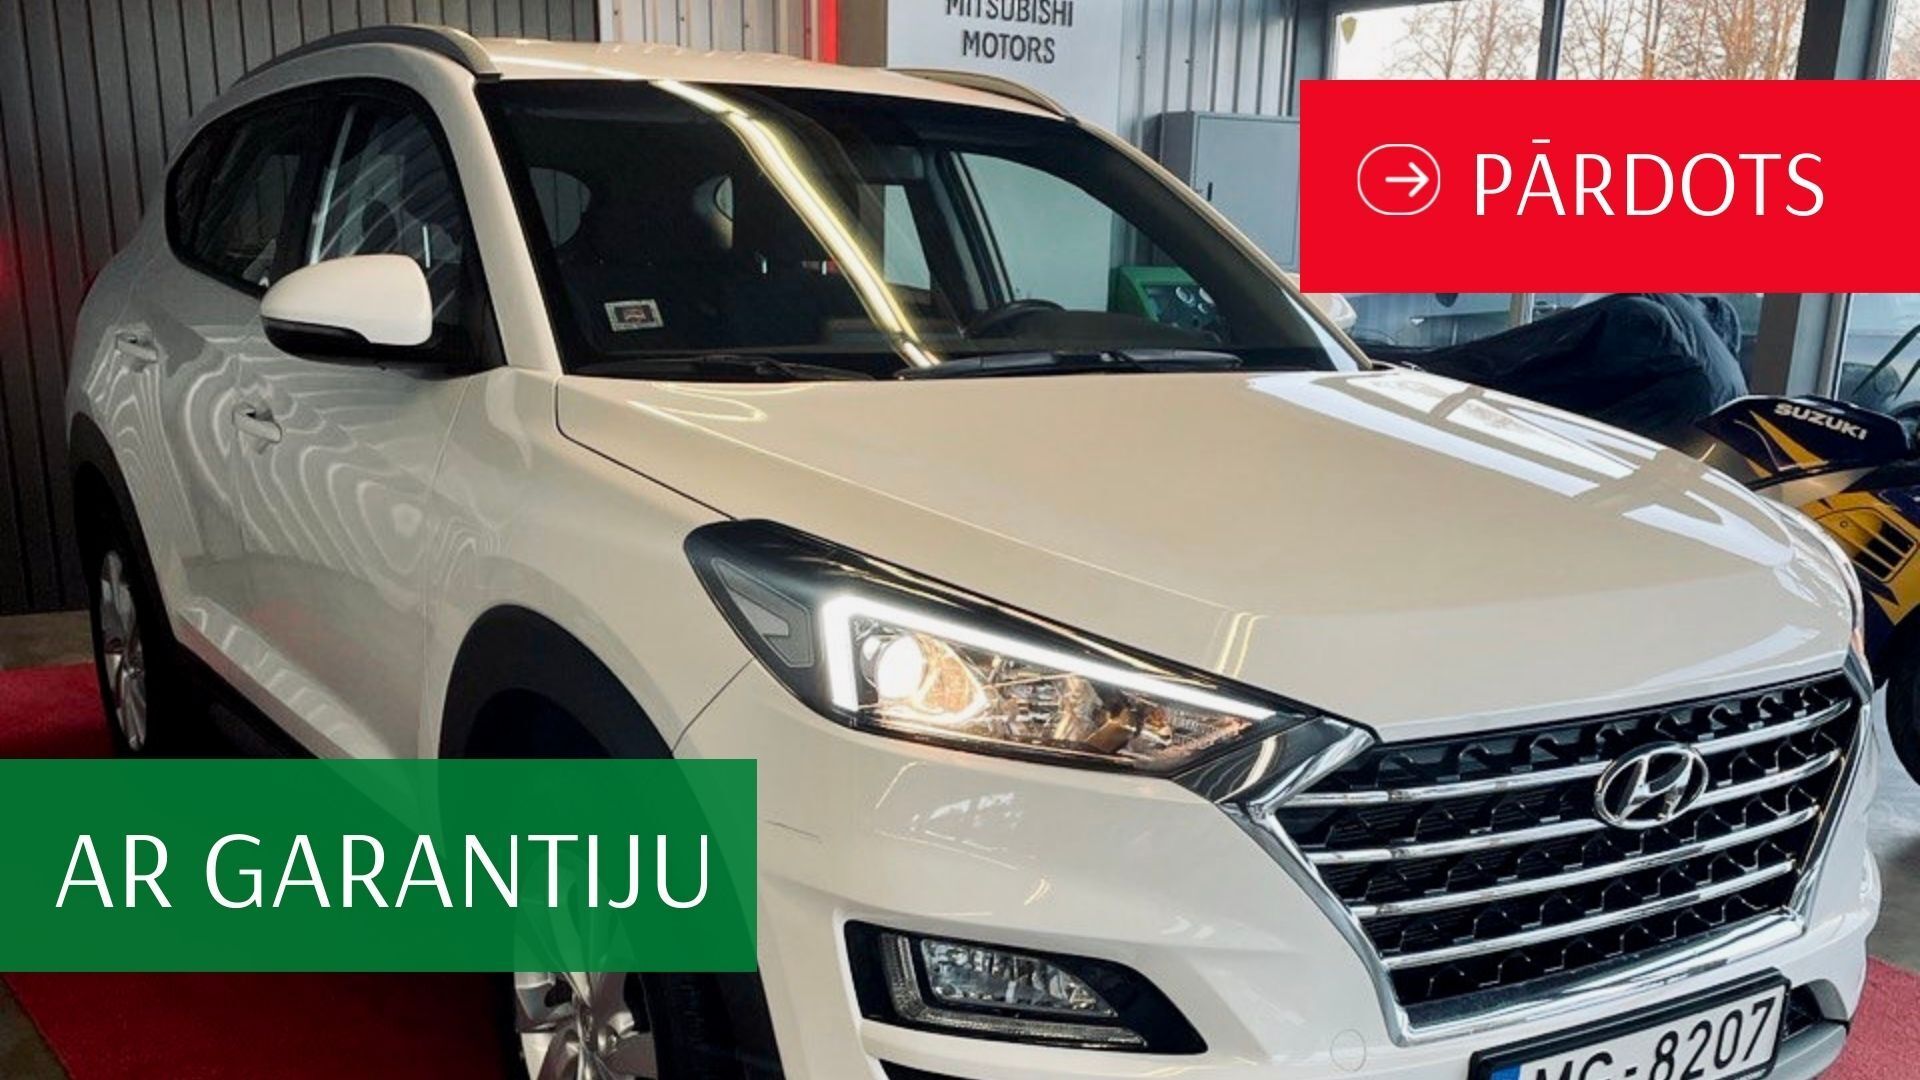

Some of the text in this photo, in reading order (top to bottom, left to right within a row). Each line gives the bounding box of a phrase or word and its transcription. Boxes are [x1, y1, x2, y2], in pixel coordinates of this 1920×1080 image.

[945, 0, 1073, 27] MITSUBISHI
[962, 30, 1055, 64] MOTORS
[1774, 402, 1868, 440] SUZUKI
